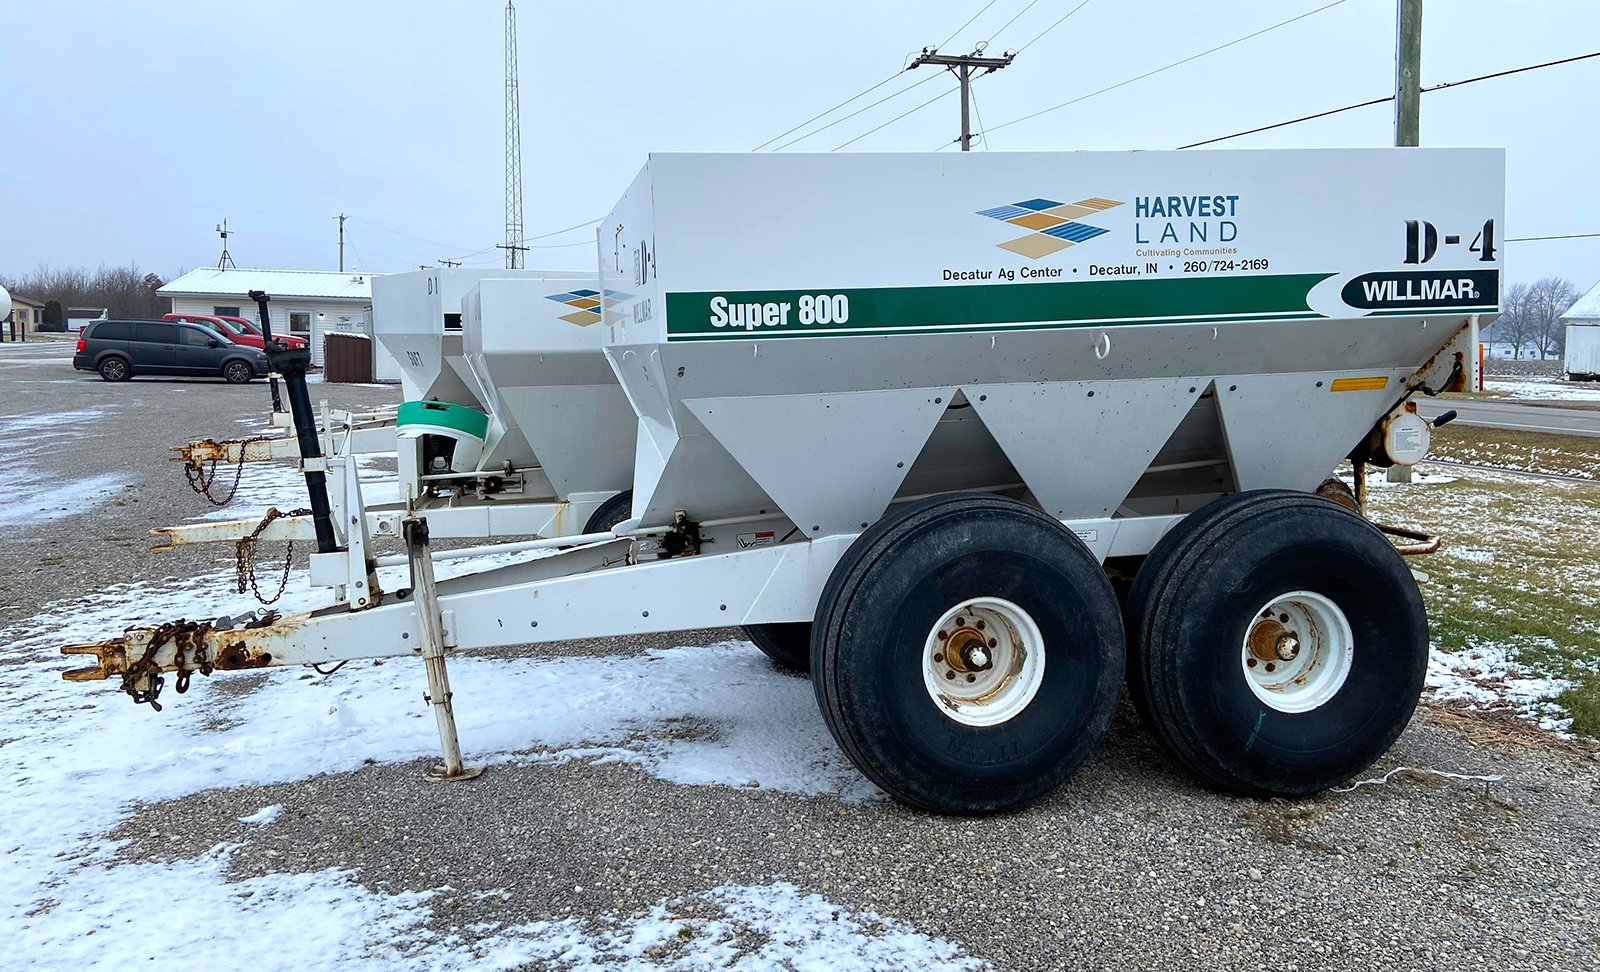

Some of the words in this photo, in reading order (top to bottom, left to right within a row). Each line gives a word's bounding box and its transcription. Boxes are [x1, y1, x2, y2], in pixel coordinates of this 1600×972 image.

[1135, 195, 1239, 218] HARVEST
[1136, 221, 1237, 243] LAND
[1403, 218, 1497, 264] D-4
[1135, 249, 1181, 258] Cultivating
[1183, 247, 1237, 256] Communities
[943, 269, 992, 280] Decatur
[998, 268, 1015, 281] Ag
[1020, 266, 1063, 278] Center
[1089, 264, 1141, 276] Decatur,
[1146, 263, 1158, 274] IN
[1183, 259, 1269, 272] 260/724-2169
[710, 296, 791, 330] Super
[798, 294, 849, 325] 800
